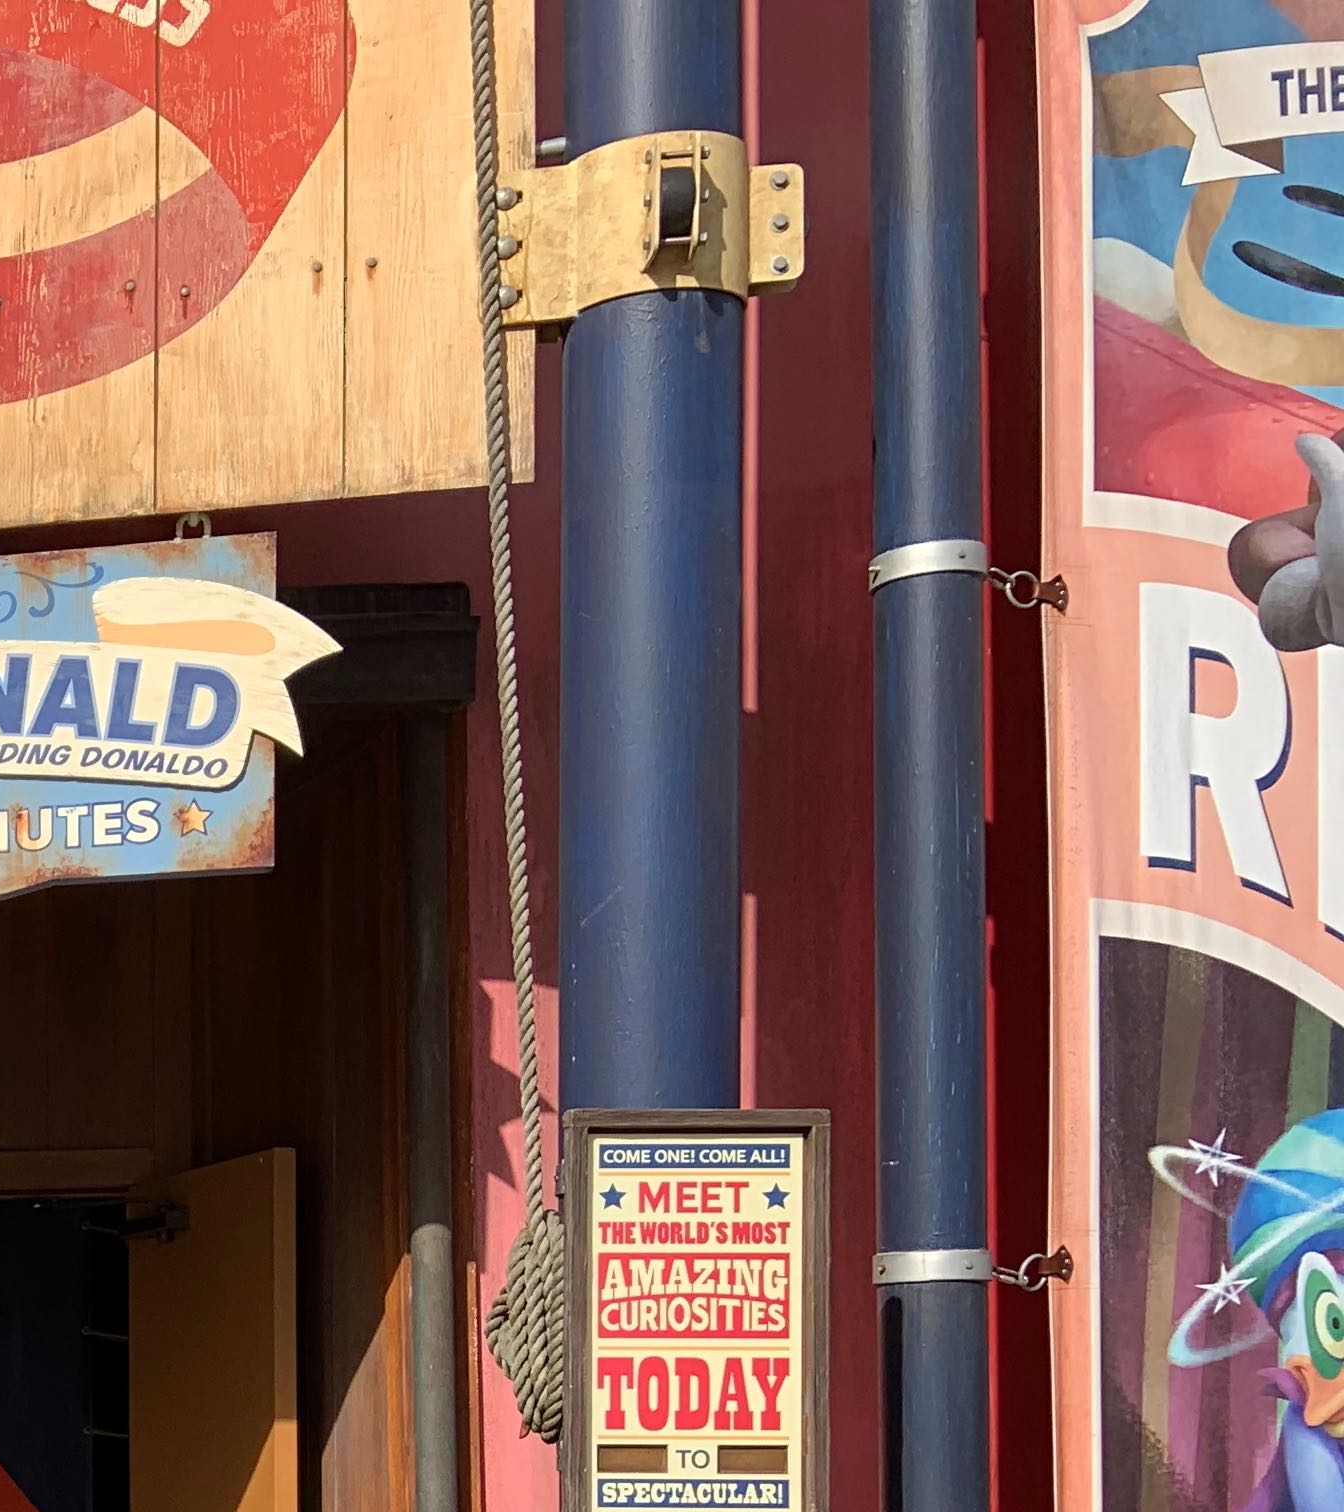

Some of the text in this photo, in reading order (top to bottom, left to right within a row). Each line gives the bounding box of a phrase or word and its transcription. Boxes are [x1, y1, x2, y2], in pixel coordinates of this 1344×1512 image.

[1270, 66, 1344, 117] THE
[80, 749, 229, 780] DONALDO
[603, 1148, 786, 1164] COME ONE! COME ALL!
[638, 1181, 750, 1214] MEET
[598, 1220, 791, 1245] THE WORLD'S MOST
[601, 1258, 789, 1301] AMAZING
[600, 1296, 787, 1332] CURIOSITIES
[597, 1355, 791, 1432] TODAY
[675, 1448, 711, 1470] TO
[602, 1482, 784, 1505] SPECTACULAR!
